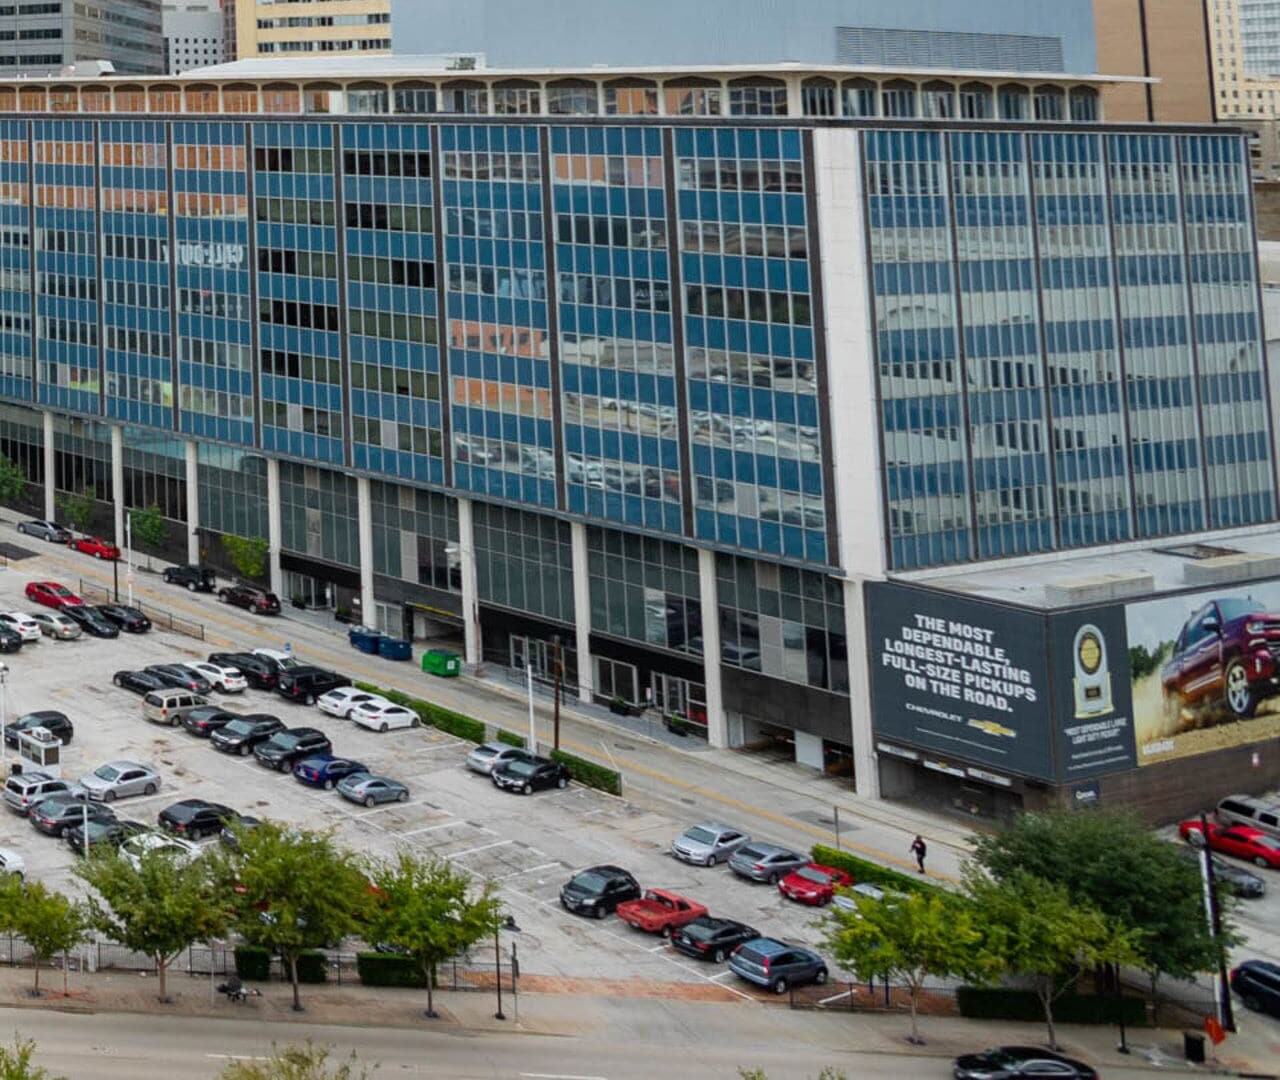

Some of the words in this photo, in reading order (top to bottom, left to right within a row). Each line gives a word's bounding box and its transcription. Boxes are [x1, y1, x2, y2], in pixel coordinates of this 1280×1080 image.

[902, 626, 1011, 666] DEPENDABLE,
[914, 614, 947, 633] THE
[949, 621, 995, 643] MOST
[882, 653, 962, 683] FULL-SIZE
[964, 673, 1037, 702] PICKUPS
[885, 638, 1032, 684] LONGEST-LASTING
[905, 674, 927, 691] ON
[929, 679, 961, 699] THE
[964, 688, 1014, 713] ROAD.
[905, 703, 963, 722] CHEVROLET
